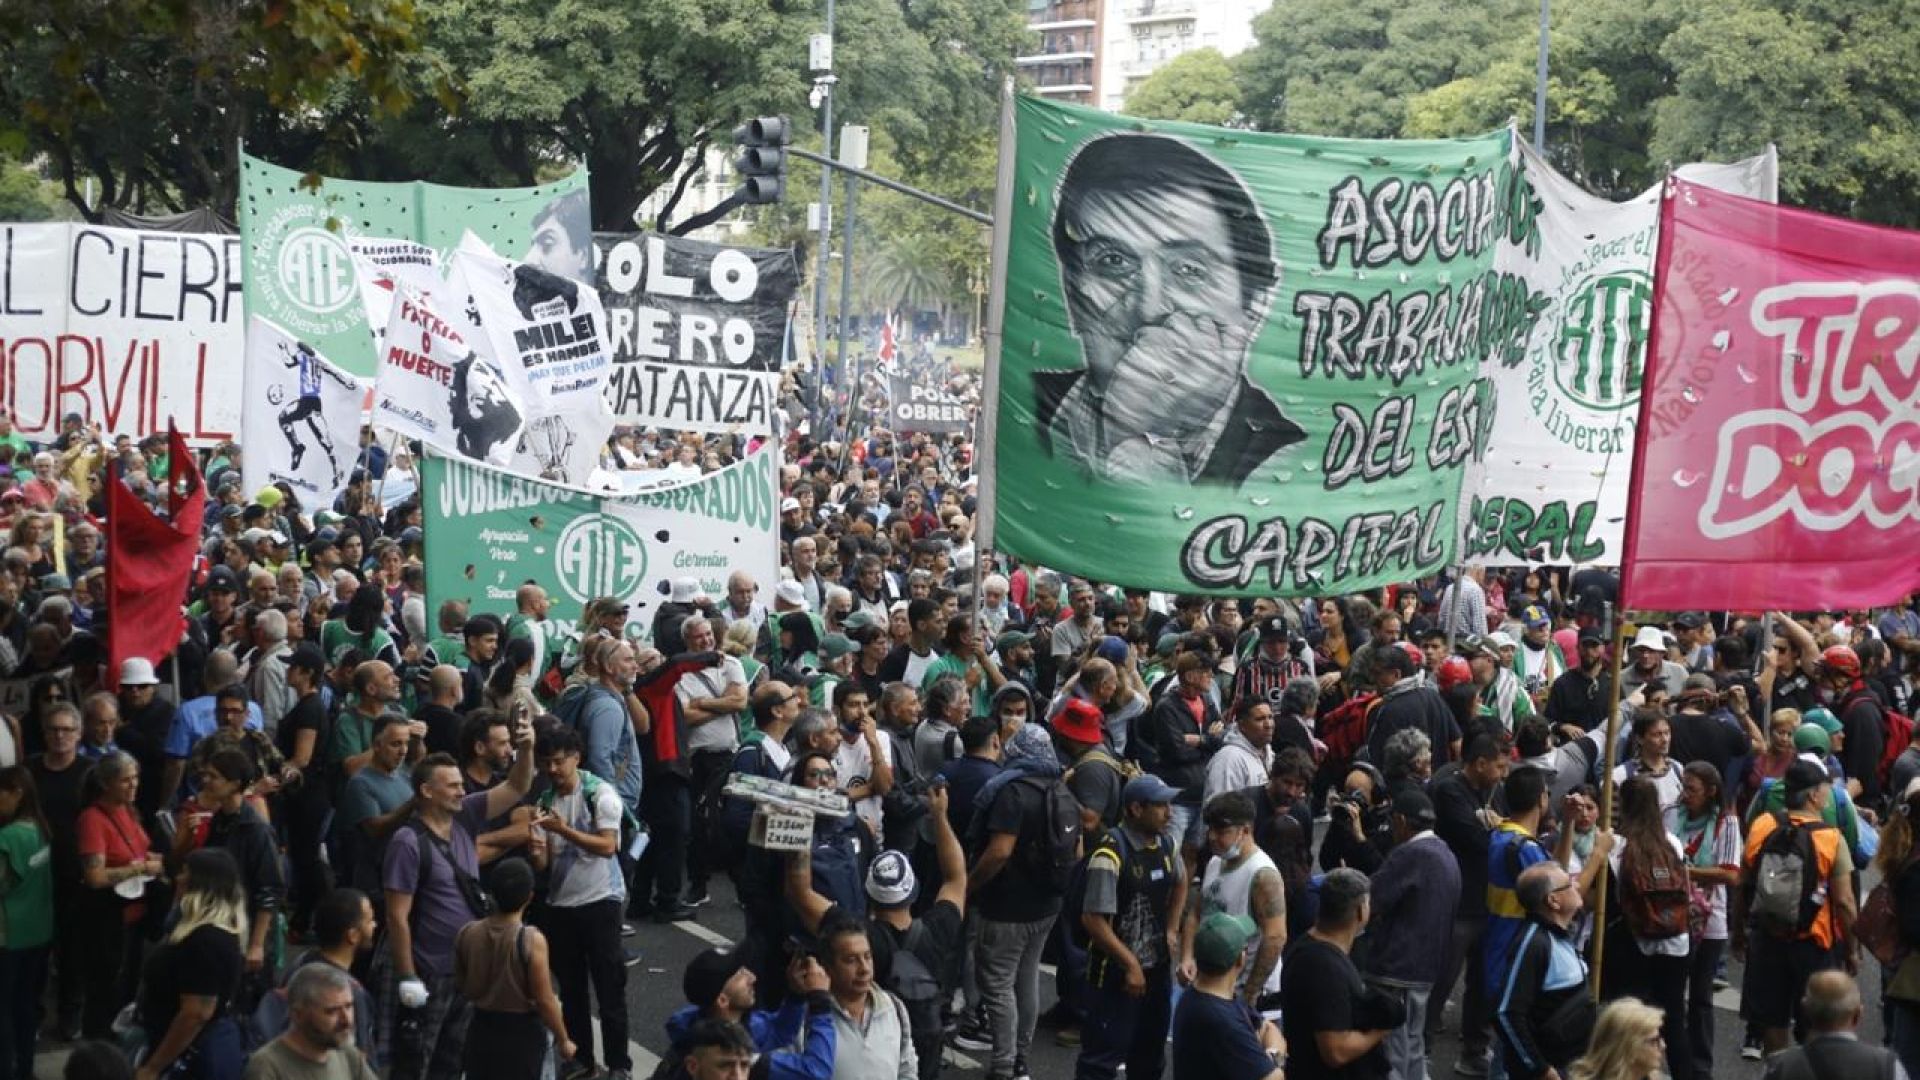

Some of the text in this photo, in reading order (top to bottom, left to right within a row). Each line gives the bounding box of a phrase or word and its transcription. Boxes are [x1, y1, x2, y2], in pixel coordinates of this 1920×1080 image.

[0, 227, 43, 316] L
[284, 238, 351, 306] ATE
[593, 236, 758, 303] OLO
[513, 312, 597, 353] MILEI
[521, 353, 544, 369] ES
[0, 334, 233, 441] ORVILL
[387, 346, 452, 387] MUERTE
[911, 384, 960, 405] POL
[1322, 394, 1417, 491] DEL
[1543, 398, 1624, 454] liberar
[562, 520, 637, 600] ATE
[1179, 499, 1446, 591] CAPITAL
